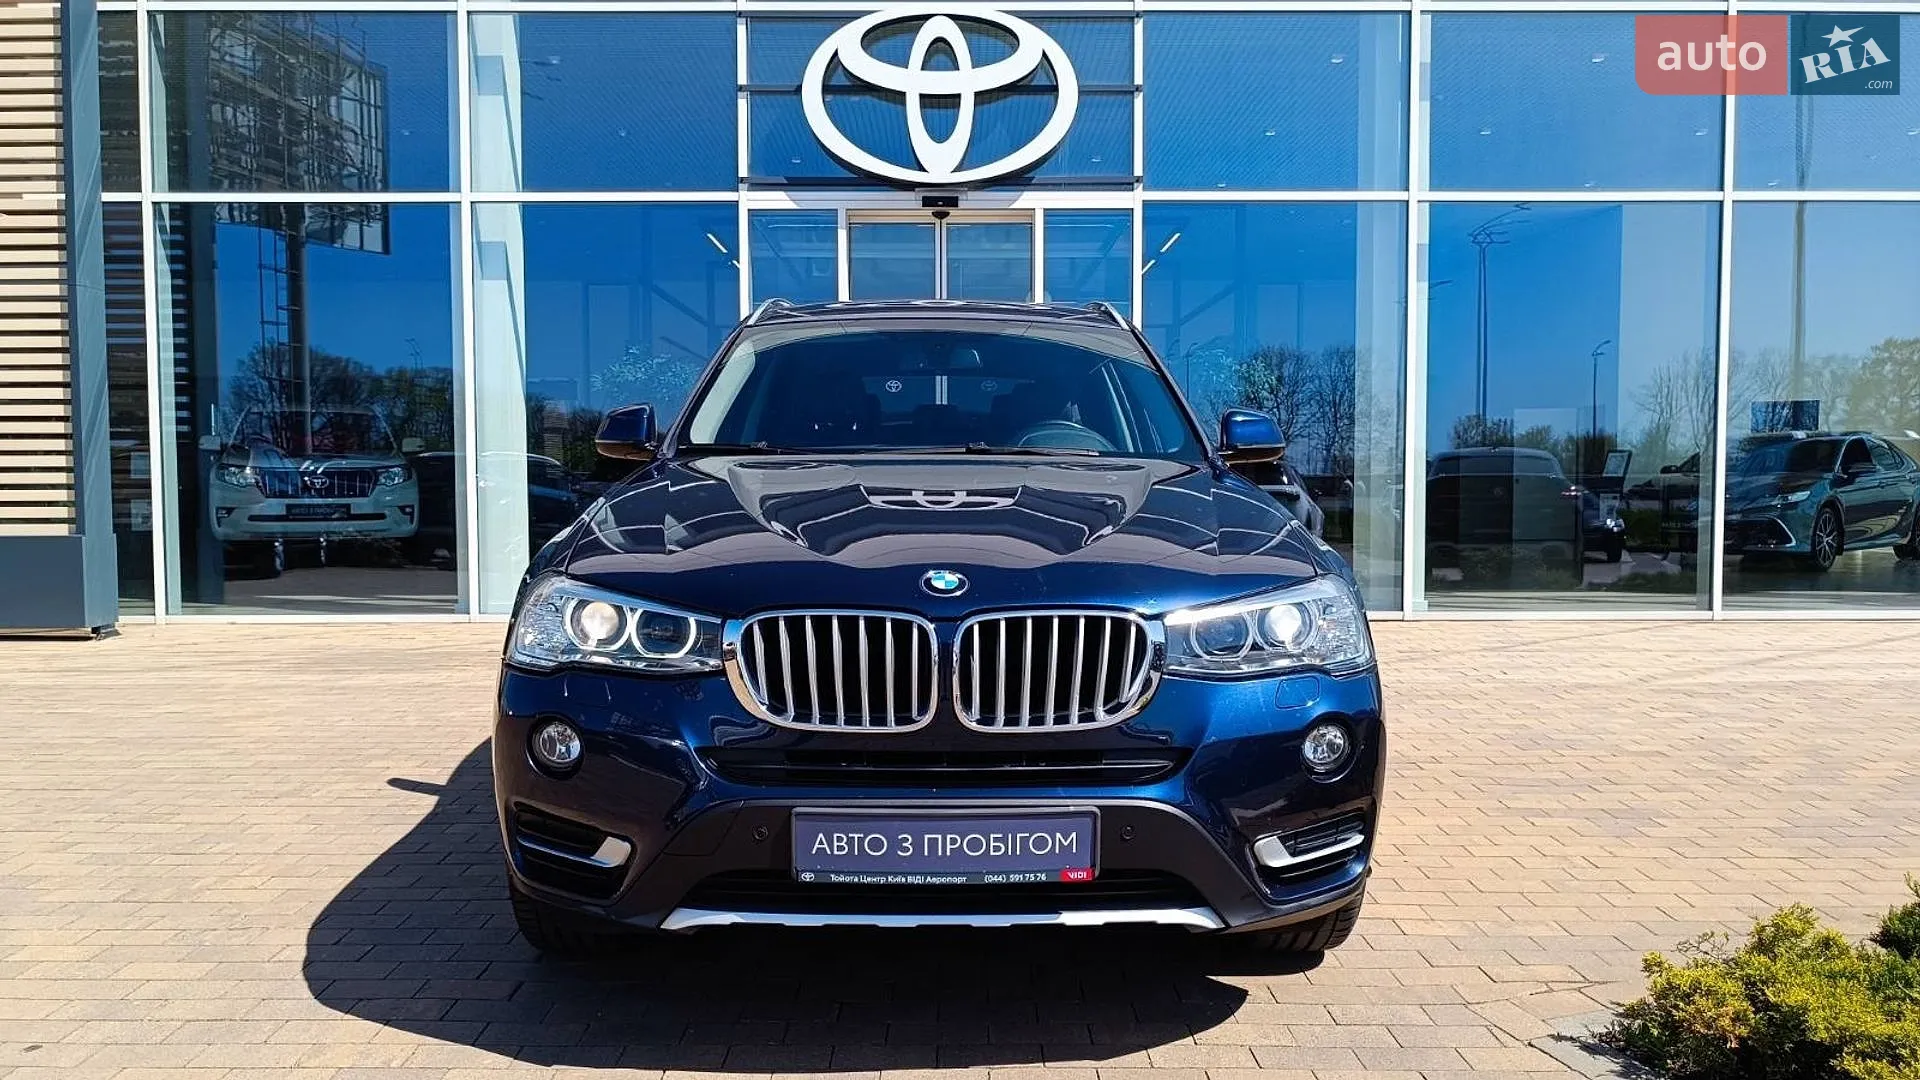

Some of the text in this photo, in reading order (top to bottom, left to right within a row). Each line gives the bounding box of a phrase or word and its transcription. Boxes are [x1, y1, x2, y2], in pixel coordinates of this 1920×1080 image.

[812, 832, 1077, 856] АВТО З ПРОБІГОМ
[830, 874, 858, 882] Тойота
[860, 875, 886, 884] Центр
[888, 875, 906, 883] Київ
[926, 876, 967, 884] Аеропорт
[984, 873, 1006, 883] (044)
[1067, 871, 1087, 879] VIDI
